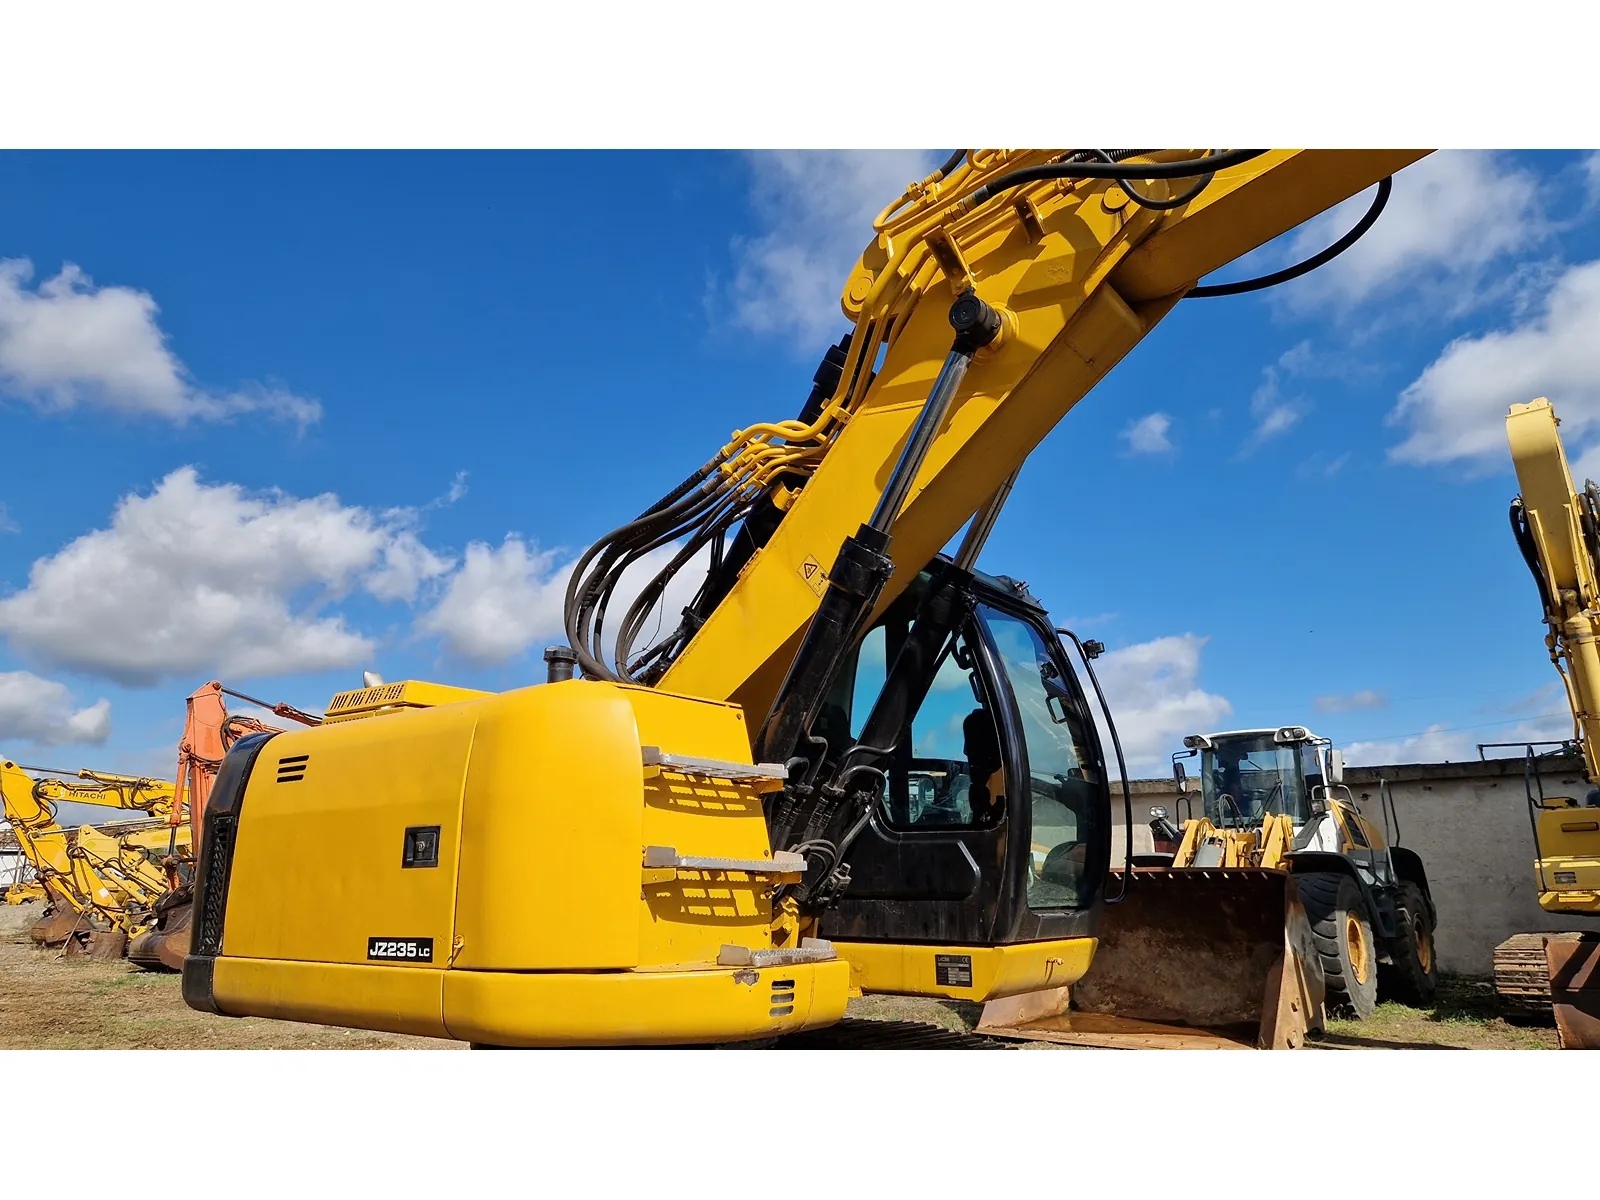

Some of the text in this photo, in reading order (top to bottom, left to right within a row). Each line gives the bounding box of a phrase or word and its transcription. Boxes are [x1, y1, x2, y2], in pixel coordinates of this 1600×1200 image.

[69, 791, 106, 800] HITACHI
[370, 942, 430, 957] JZ235 LC
